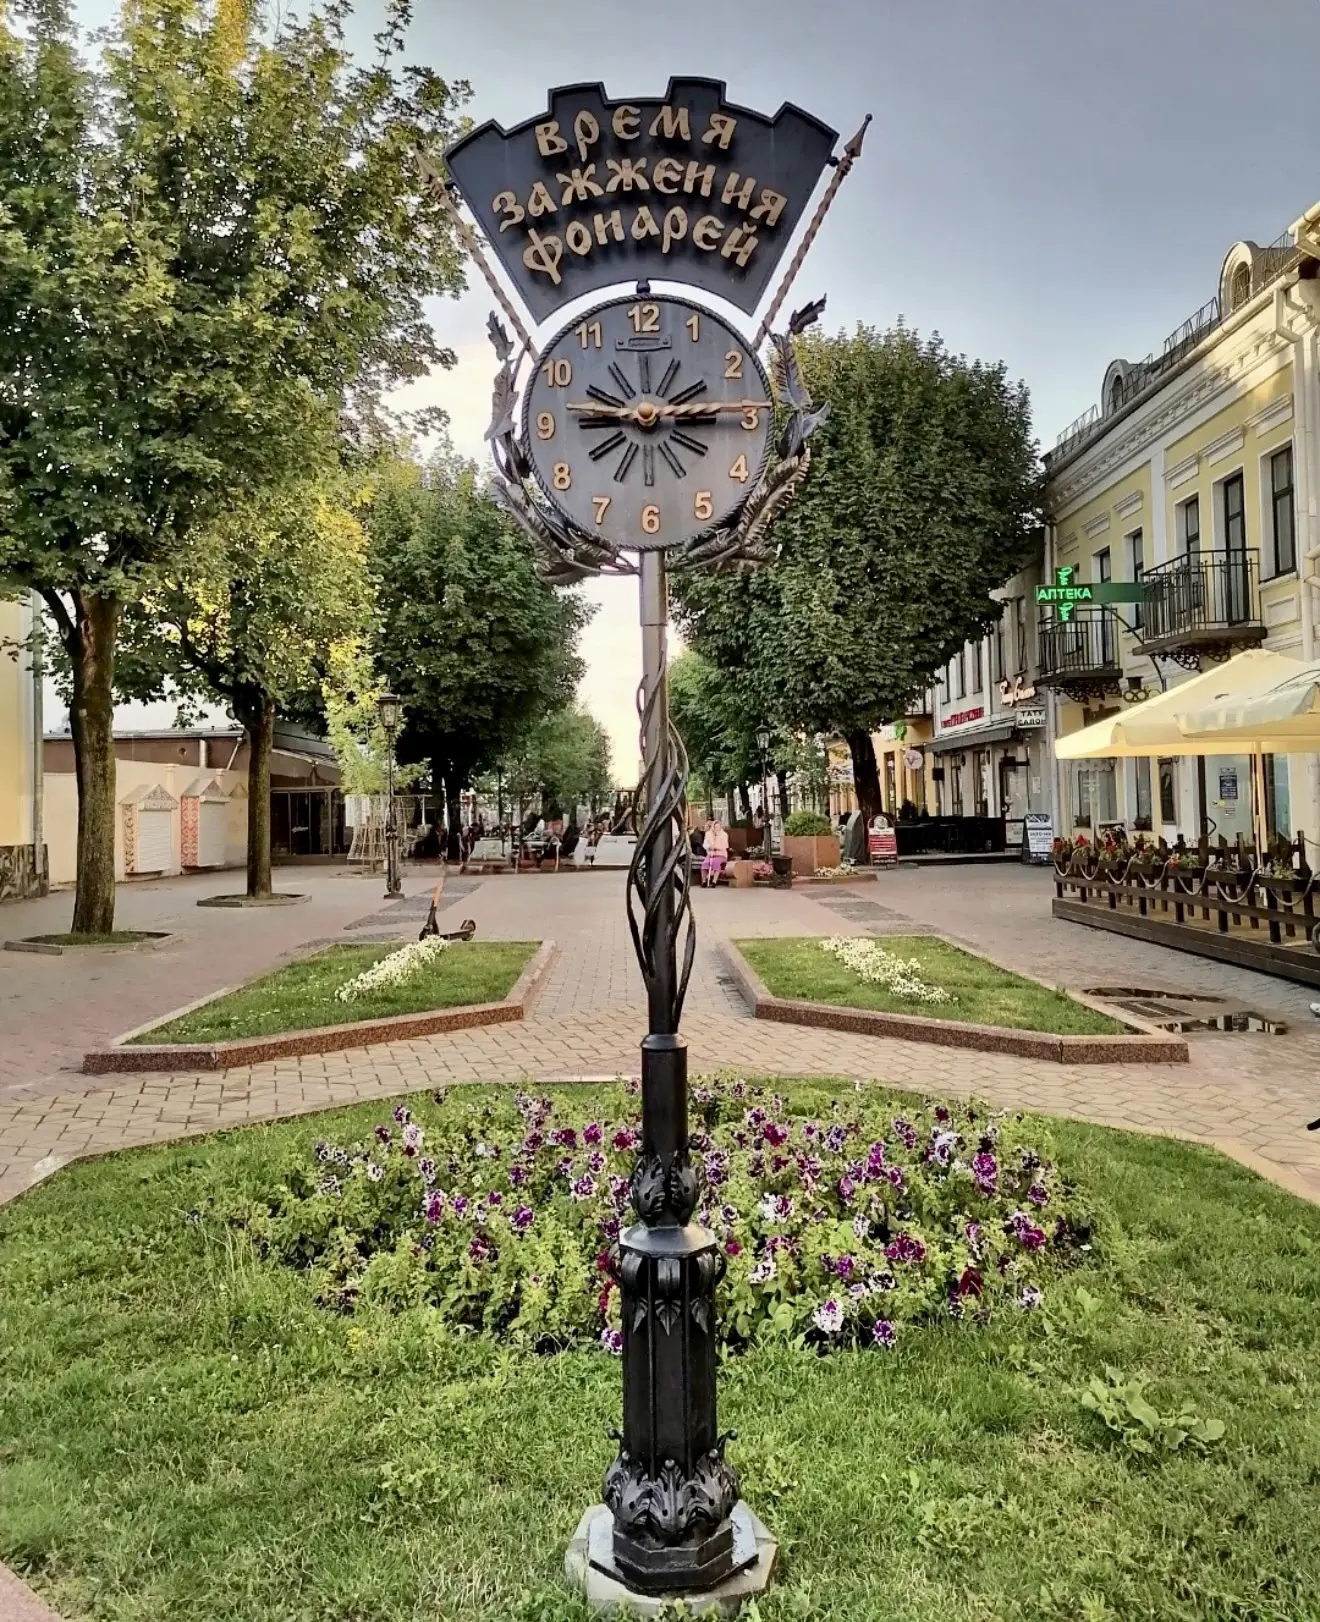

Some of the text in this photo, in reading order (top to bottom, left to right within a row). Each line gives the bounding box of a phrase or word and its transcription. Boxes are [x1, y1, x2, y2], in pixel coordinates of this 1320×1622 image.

[534, 104, 738, 163] ВРЕМЯ
[491, 156, 789, 233] ЗАЖЖЕНИЯ
[522, 205, 759, 285] ФОНАРЕЙ
[627, 304, 660, 332] 12
[686, 314, 700, 342] 1
[575, 322, 602, 349] 11
[543, 358, 572, 387] 10
[724, 351, 743, 379] 2
[537, 412, 555, 440] 9
[740, 403, 759, 430] 3
[553, 462, 571, 491] 8
[729, 454, 749, 483] 4
[592, 496, 611, 524] 7
[642, 505, 660, 534] 6
[694, 491, 713, 520] 5
[1037, 587, 1092, 600] АПТЕКА
